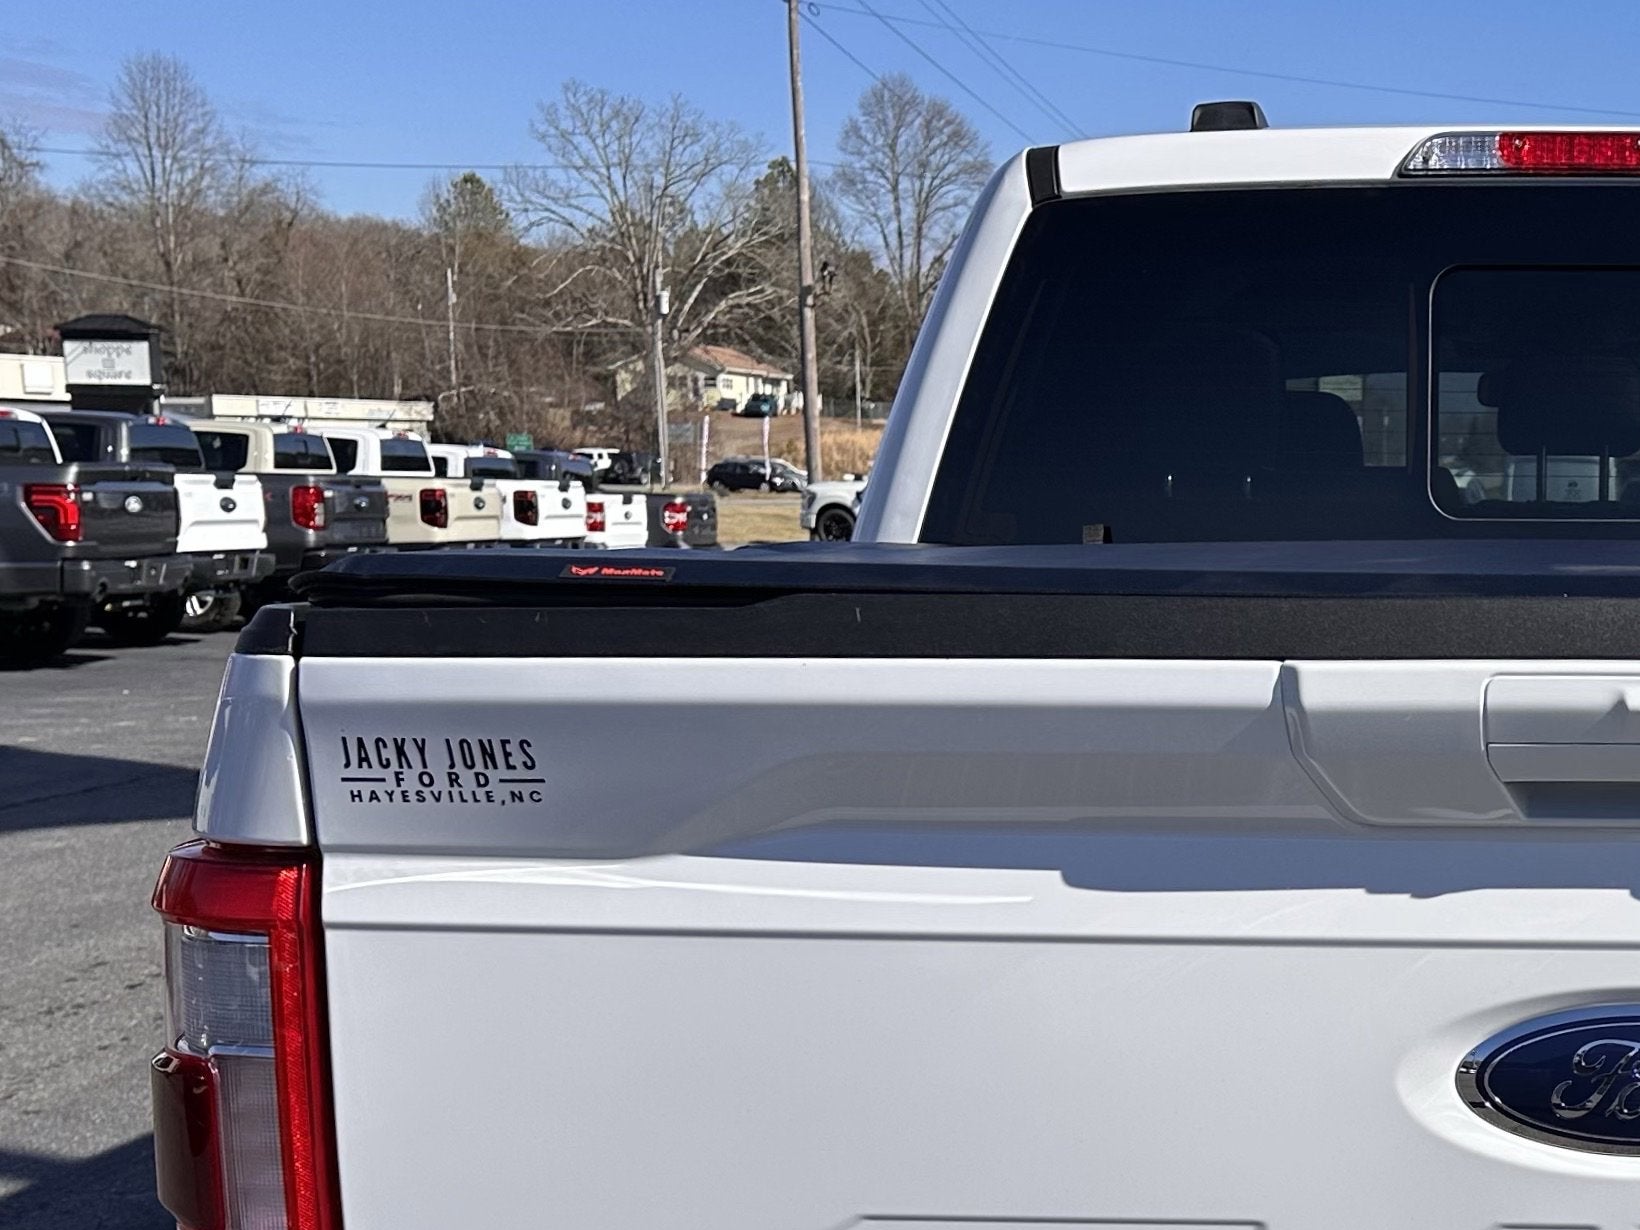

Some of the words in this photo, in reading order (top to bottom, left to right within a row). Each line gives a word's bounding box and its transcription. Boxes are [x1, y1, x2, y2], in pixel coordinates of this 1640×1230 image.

[341, 736, 428, 769] JACKY
[445, 738, 536, 770] JONES
[394, 771, 490, 788] FORD
